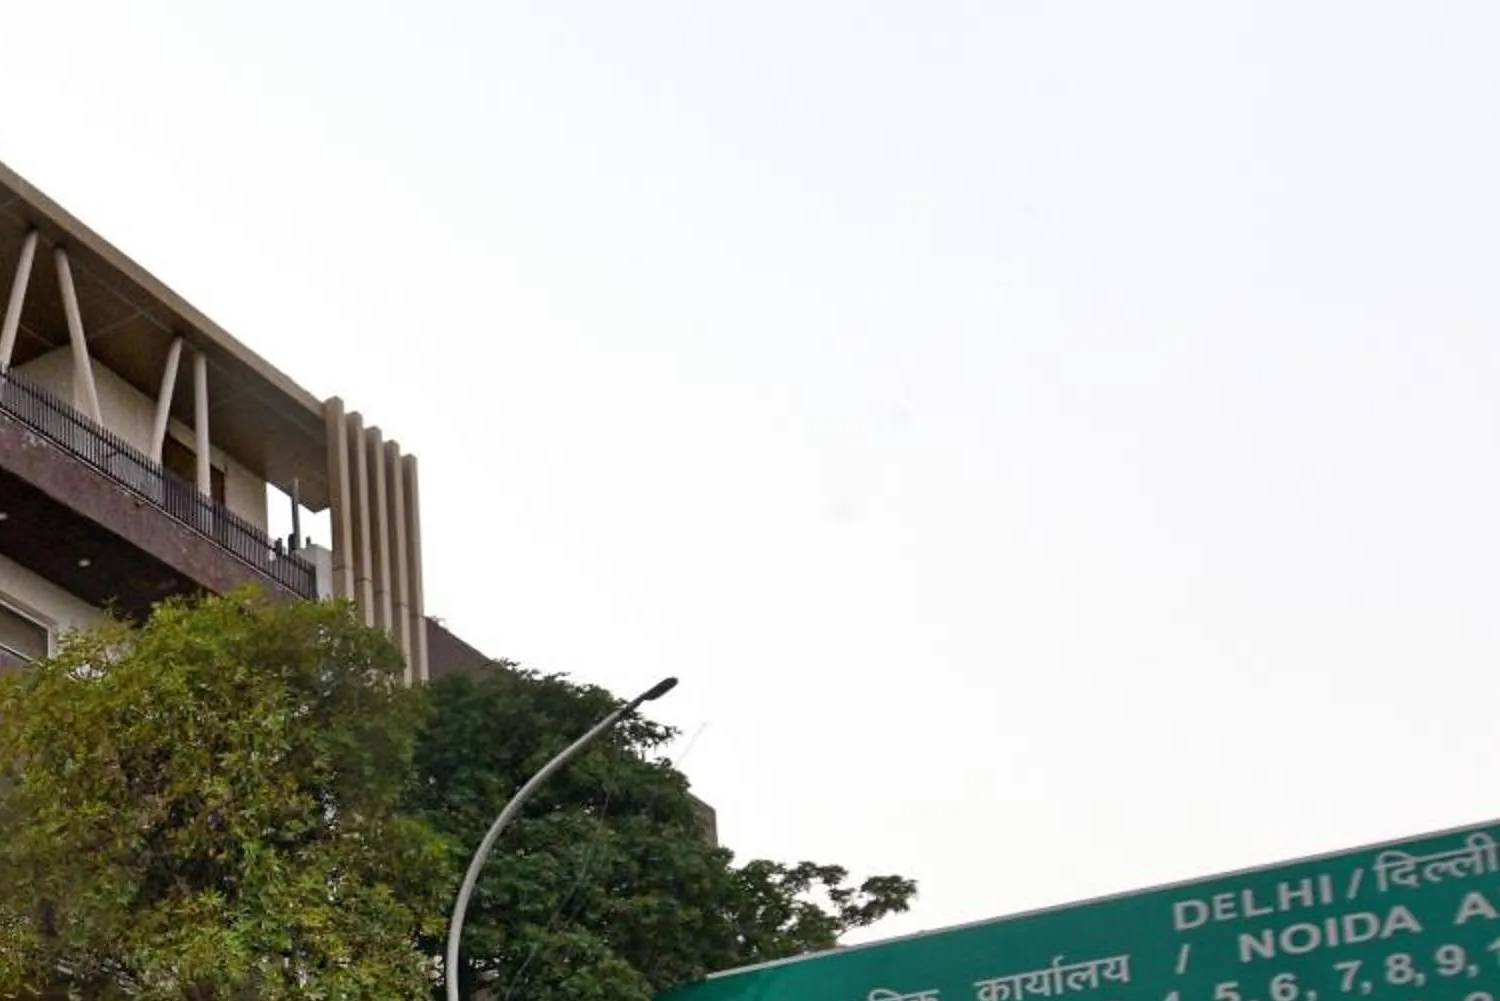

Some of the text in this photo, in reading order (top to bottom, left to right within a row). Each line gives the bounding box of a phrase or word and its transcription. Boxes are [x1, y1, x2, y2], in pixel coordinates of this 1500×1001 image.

[1172, 873, 1333, 931] DELHI
[1372, 831, 1500, 893] दिल्ली
[1238, 905, 1422, 962] NOIDA
[1454, 891, 1500, 925] A
